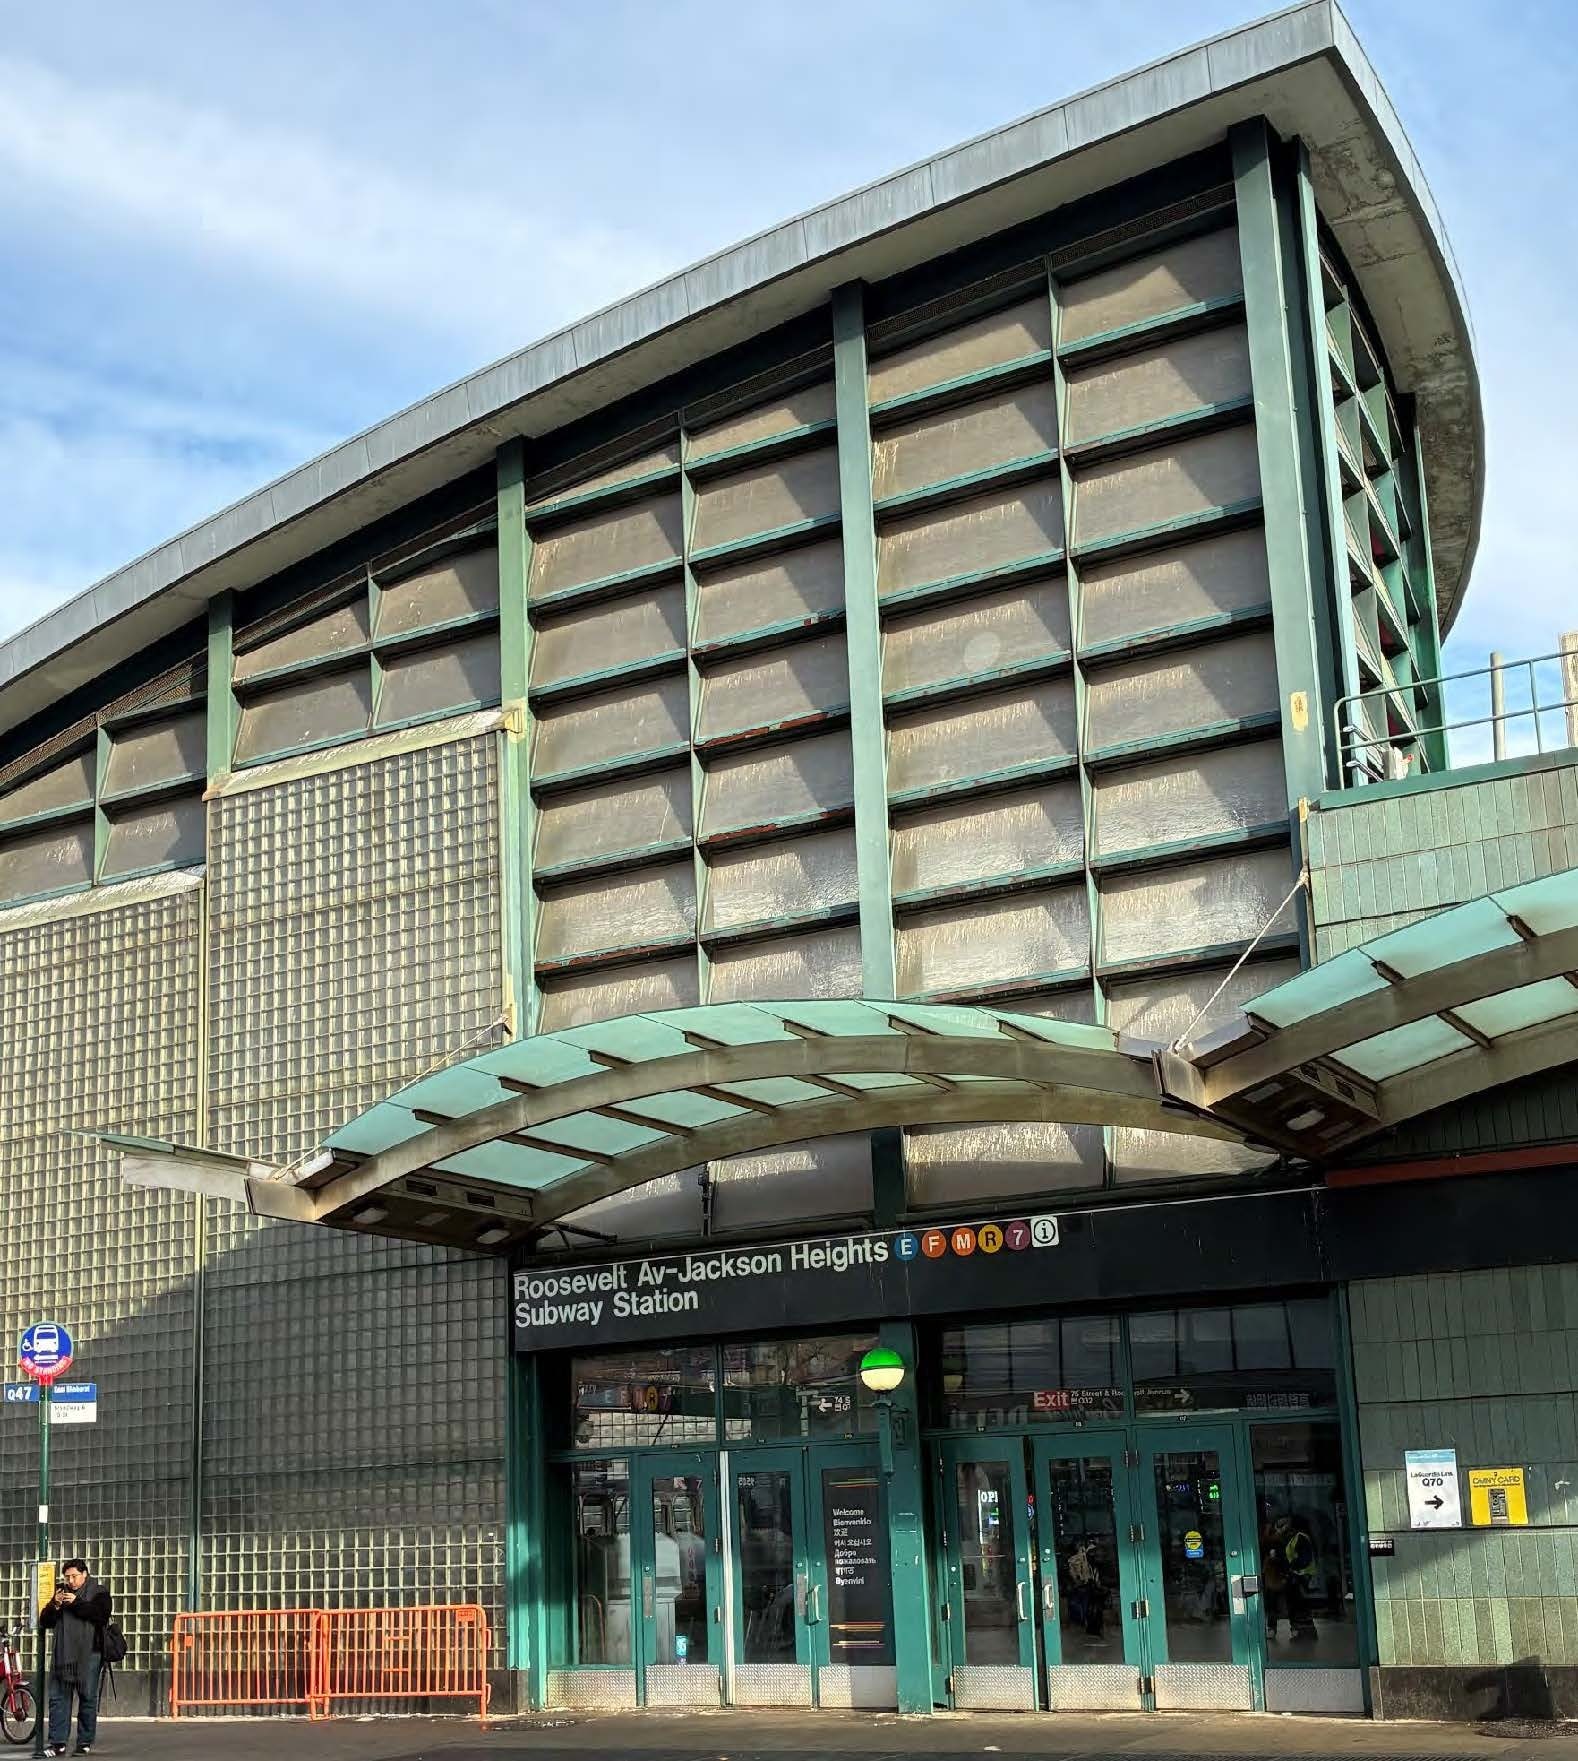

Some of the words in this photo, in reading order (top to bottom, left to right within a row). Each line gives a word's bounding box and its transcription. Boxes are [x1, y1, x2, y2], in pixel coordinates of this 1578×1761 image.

[514, 1264, 627, 1300] Roosevelt
[791, 1238, 889, 1272] Heights
[901, 1238, 913, 1256] E
[928, 1235, 940, 1253] F
[956, 1233, 971, 1250] M
[985, 1230, 997, 1248] R
[1012, 1229, 1024, 1246] 7
[515, 1300, 604, 1328] Subway
[613, 1288, 698, 1318] Station
[7, 1386, 32, 1401] Q47
[1033, 1391, 1069, 1408] Exit
[1422, 1478, 1444, 1487] Q70
[1497, 1475, 1521, 1484] CARD
[832, 1508, 864, 1516] Welcome
